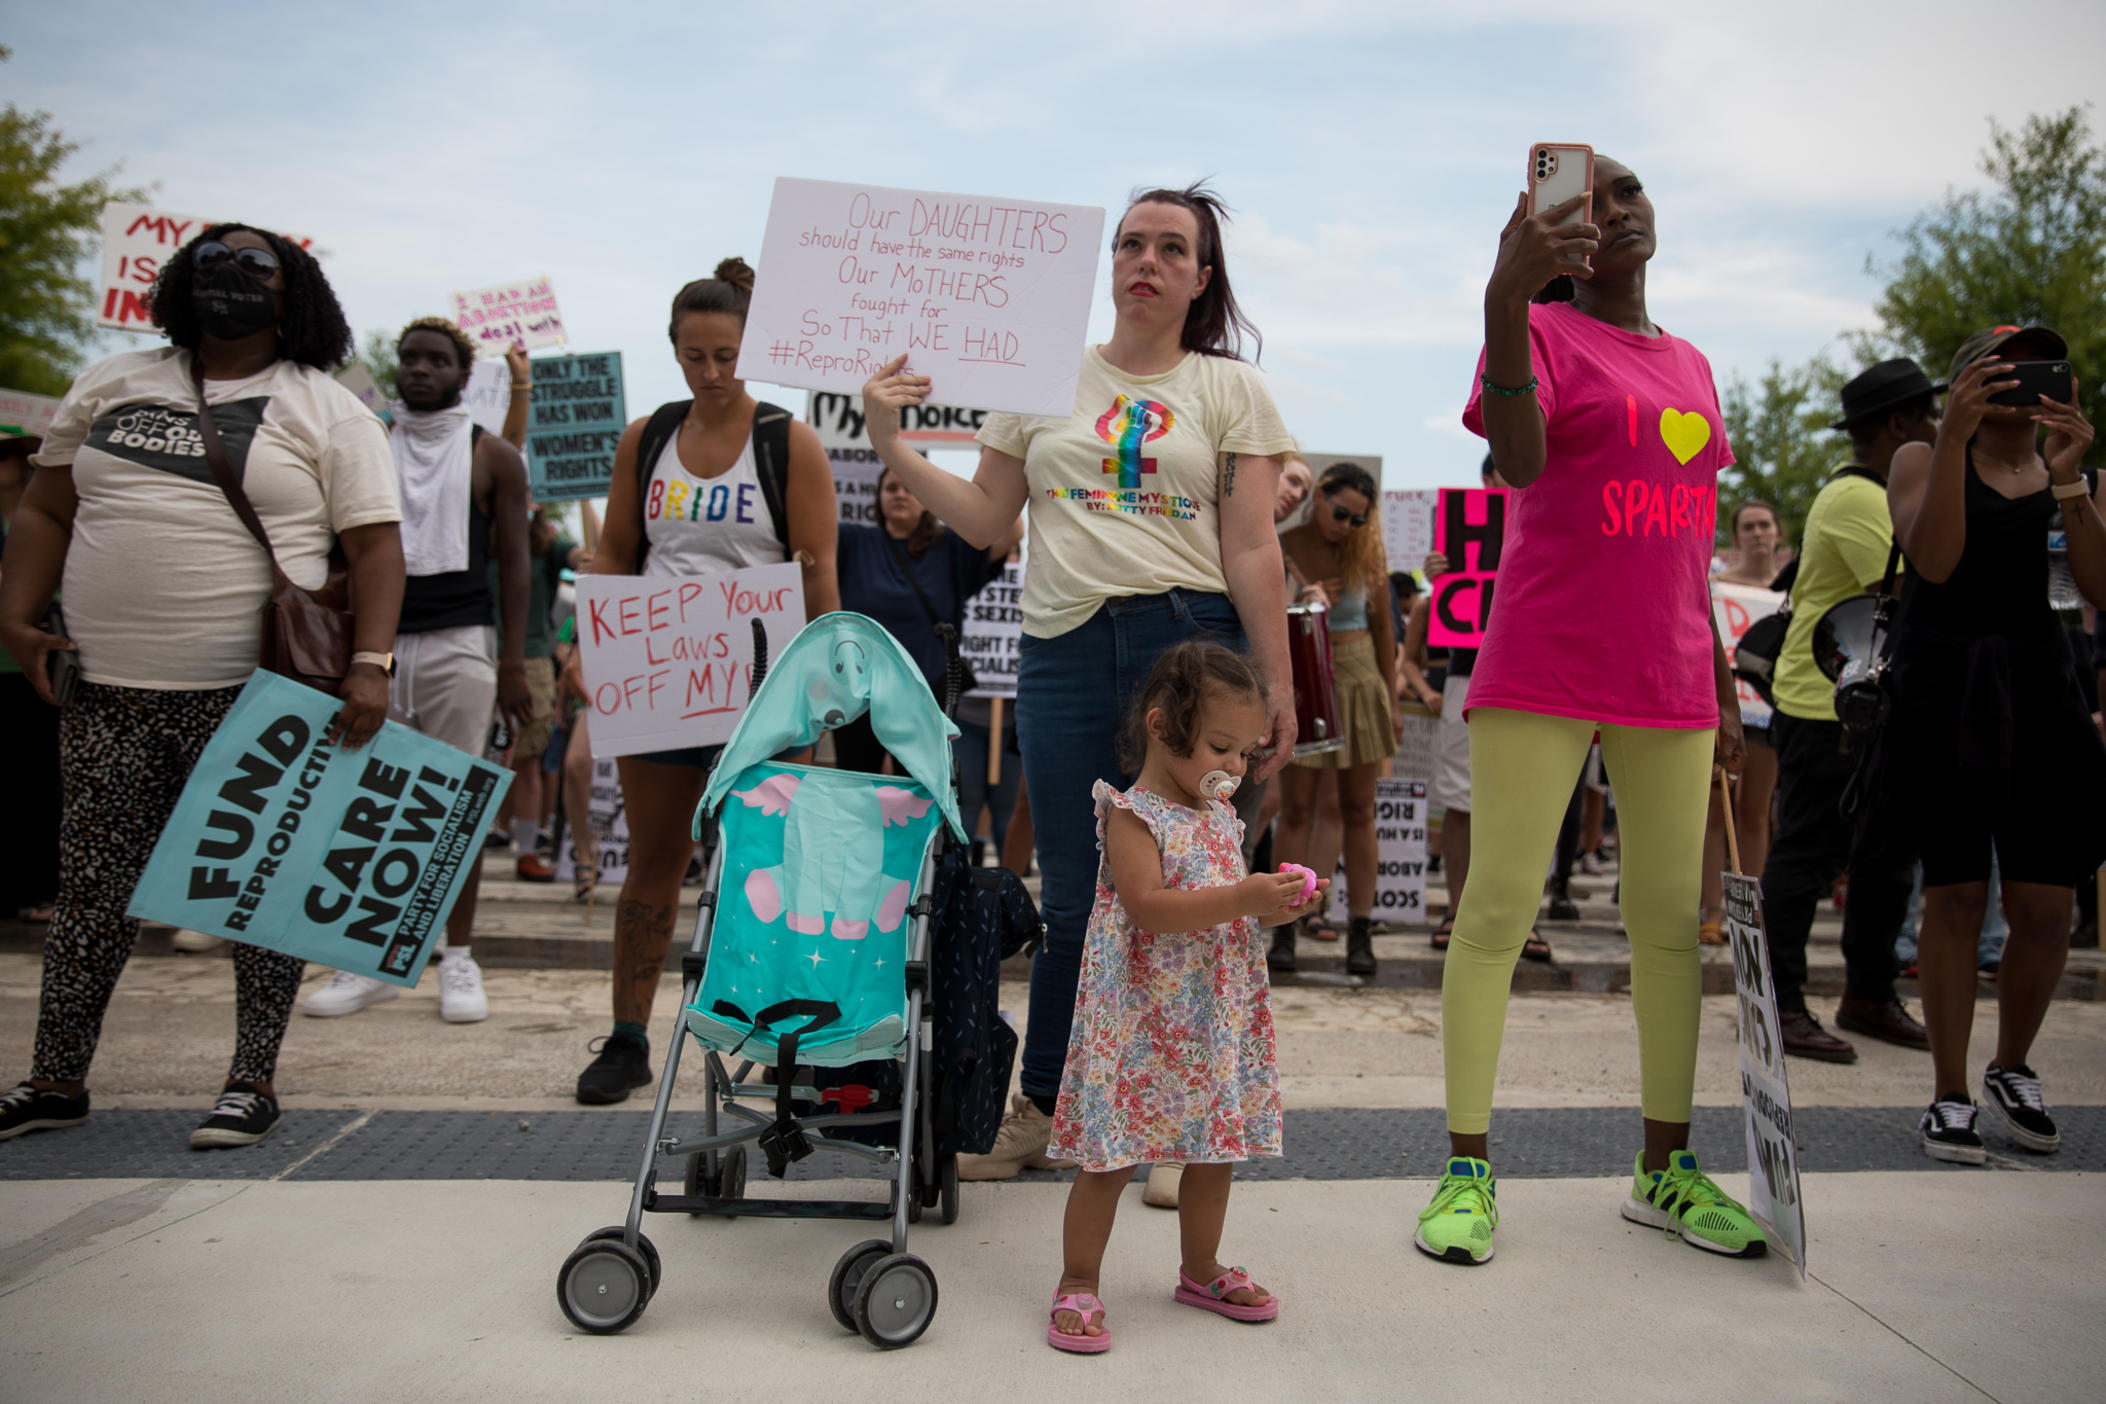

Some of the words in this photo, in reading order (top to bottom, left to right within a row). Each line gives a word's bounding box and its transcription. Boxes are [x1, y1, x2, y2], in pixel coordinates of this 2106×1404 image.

[126, 214, 193, 247] MY
[849, 192, 901, 232] Our
[908, 197, 1068, 254] DAUGHTERS
[799, 226, 860, 251] should
[870, 236, 904, 256] have
[907, 237, 932, 259] the
[937, 247, 974, 262] same
[979, 248, 1025, 272] rights
[838, 255, 879, 284] Our
[850, 292, 910, 320] fought
[919, 299, 948, 319] for
[800, 308, 832, 337] So
[838, 315, 895, 346] That
[909, 322, 950, 350] WE
[964, 326, 1019, 361] HAD
[533, 360, 573, 380] ONLY
[577, 356, 610, 377] THE
[531, 378, 617, 401] STRUGGLE
[116, 415, 167, 435] OFF
[535, 404, 570, 425] HAS
[573, 402, 614, 422] WON
[1627, 393, 1638, 447] I
[106, 429, 207, 457] BODIES
[546, 457, 613, 481] RIGHTS
[648, 478, 756, 524] BRIDE
[1070, 488, 1136, 504] FEMININE
[1138, 492, 1201, 512] MYSTIQUE
[1107, 502, 1147, 515] BETTY
[1149, 505, 1197, 521] FRIEDAN
[589, 582, 704, 648] KEEP
[718, 581, 793, 620] Your
[646, 632, 730, 666] Laws
[596, 669, 672, 716] OFF
[686, 660, 738, 709] MY
[187, 713, 311, 900] FUND
[304, 757, 411, 924] CARE
[343, 765, 460, 947] NOW!
[400, 892, 428, 935] PARTY
[421, 856, 441, 889] FOR
[434, 789, 474, 862] SOCIALISM
[413, 910, 434, 941] AND
[429, 833, 470, 911] LIBERATION
